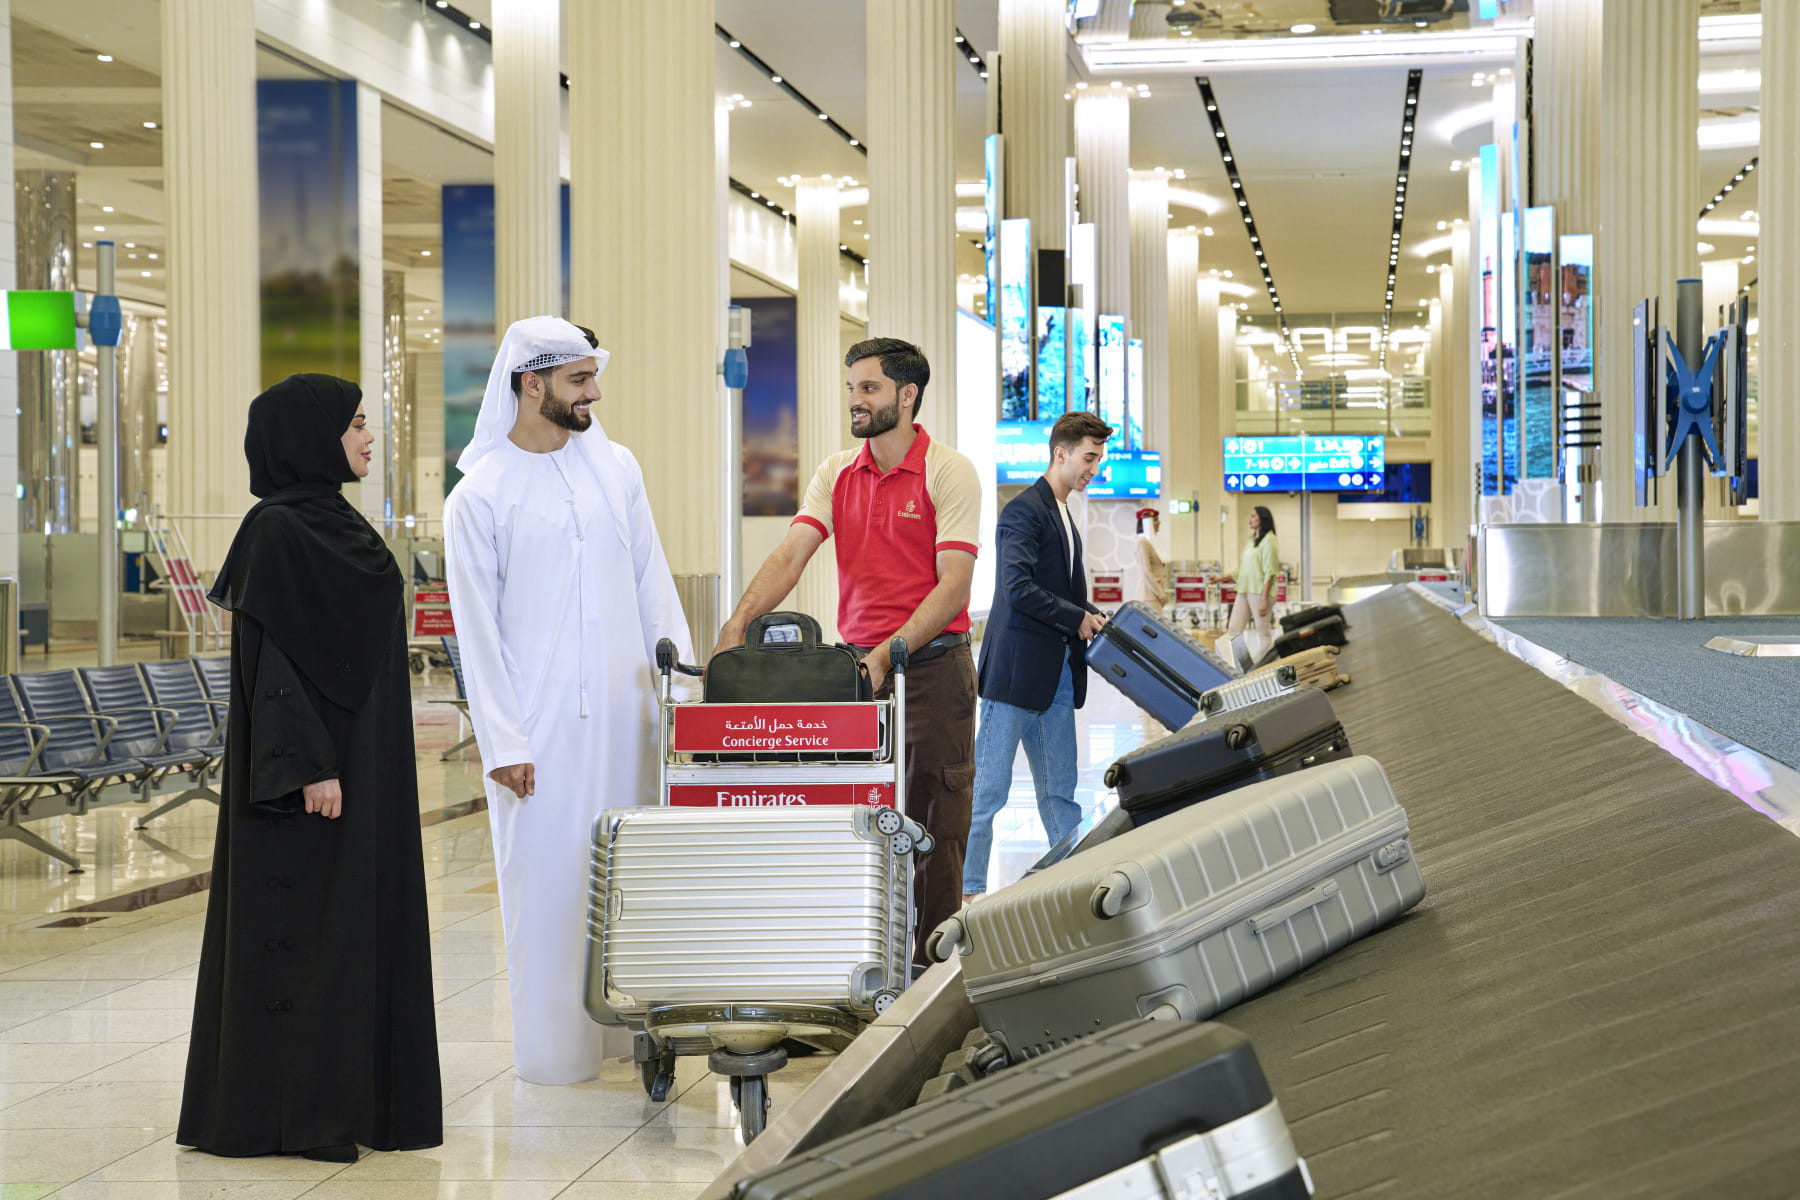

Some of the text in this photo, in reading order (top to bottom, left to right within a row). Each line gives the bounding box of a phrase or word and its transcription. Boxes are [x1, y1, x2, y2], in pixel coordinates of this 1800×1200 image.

[768, 718, 794, 733] حمل
[797, 719, 828, 729] خدمة
[722, 734, 829, 749] Concierge Service
[716, 790, 807, 808] Emirates
